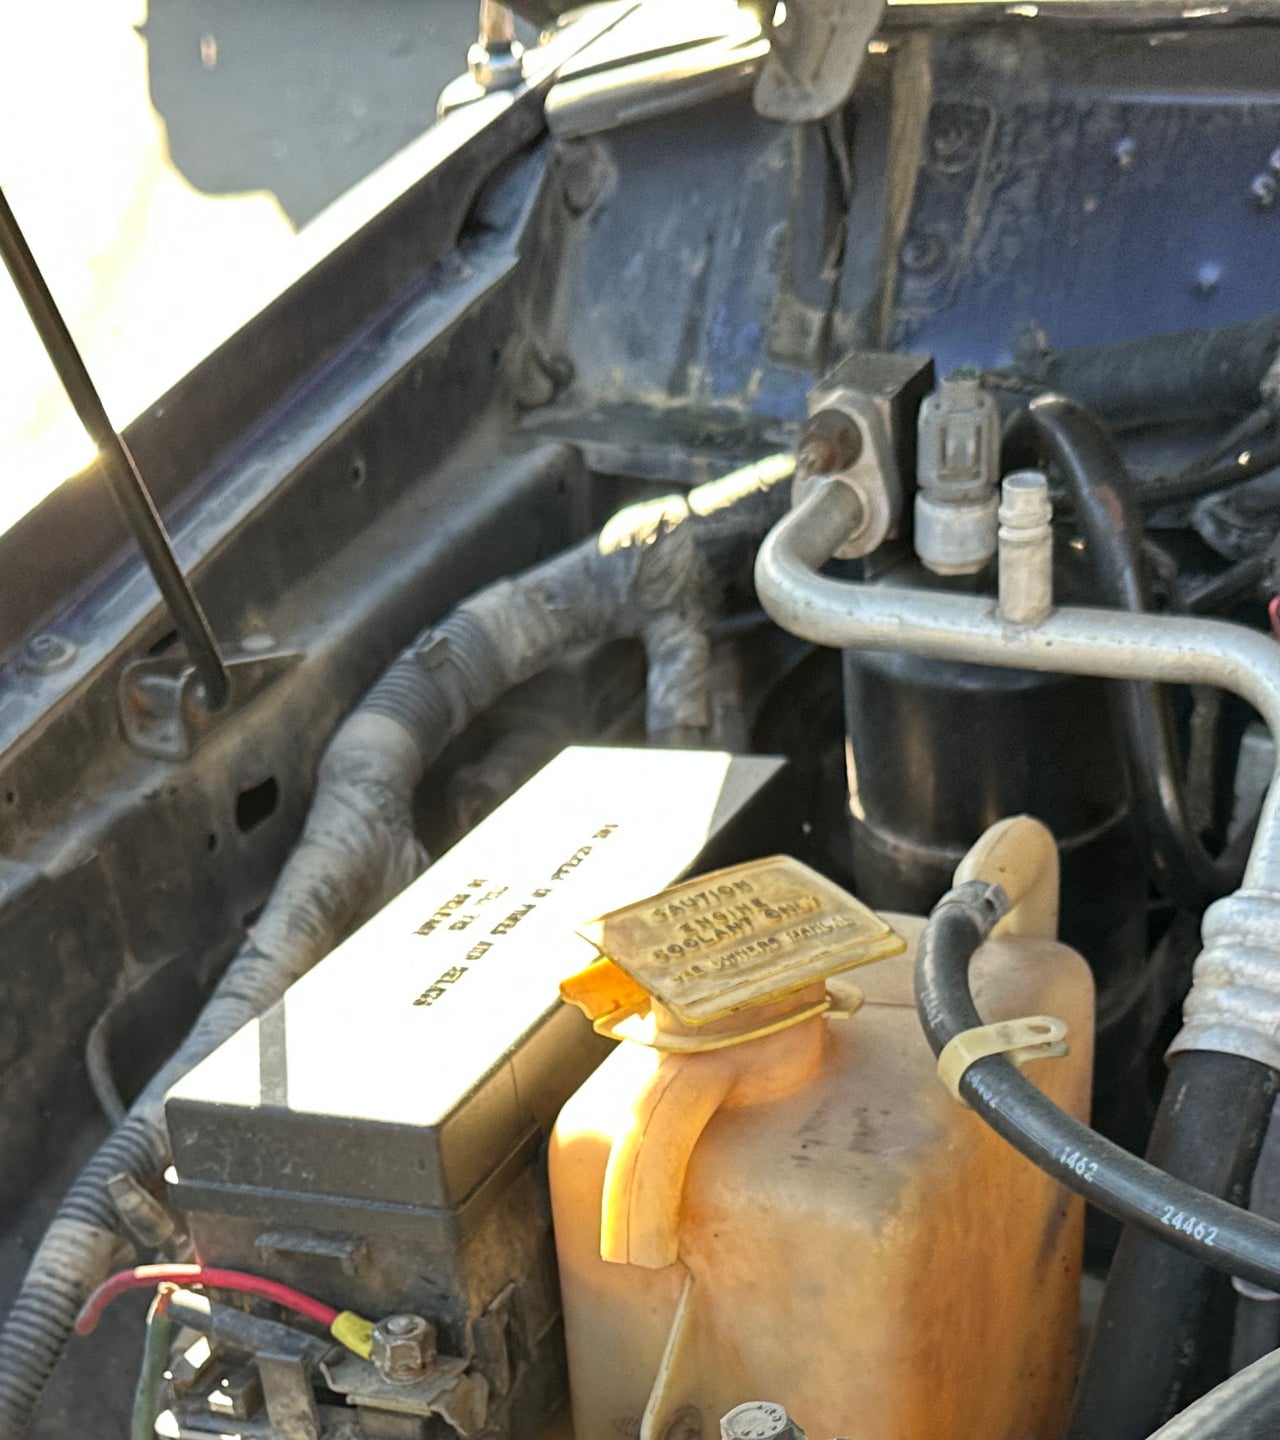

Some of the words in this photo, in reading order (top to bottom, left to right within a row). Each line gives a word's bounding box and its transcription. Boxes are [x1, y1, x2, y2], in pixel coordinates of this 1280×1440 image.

[651, 879, 755, 923] CAUTION
[678, 897, 773, 935] ENGINE
[650, 917, 755, 964] COOLANT
[763, 895, 822, 924] ONLY
[1159, 1205, 1220, 1247] 24462
